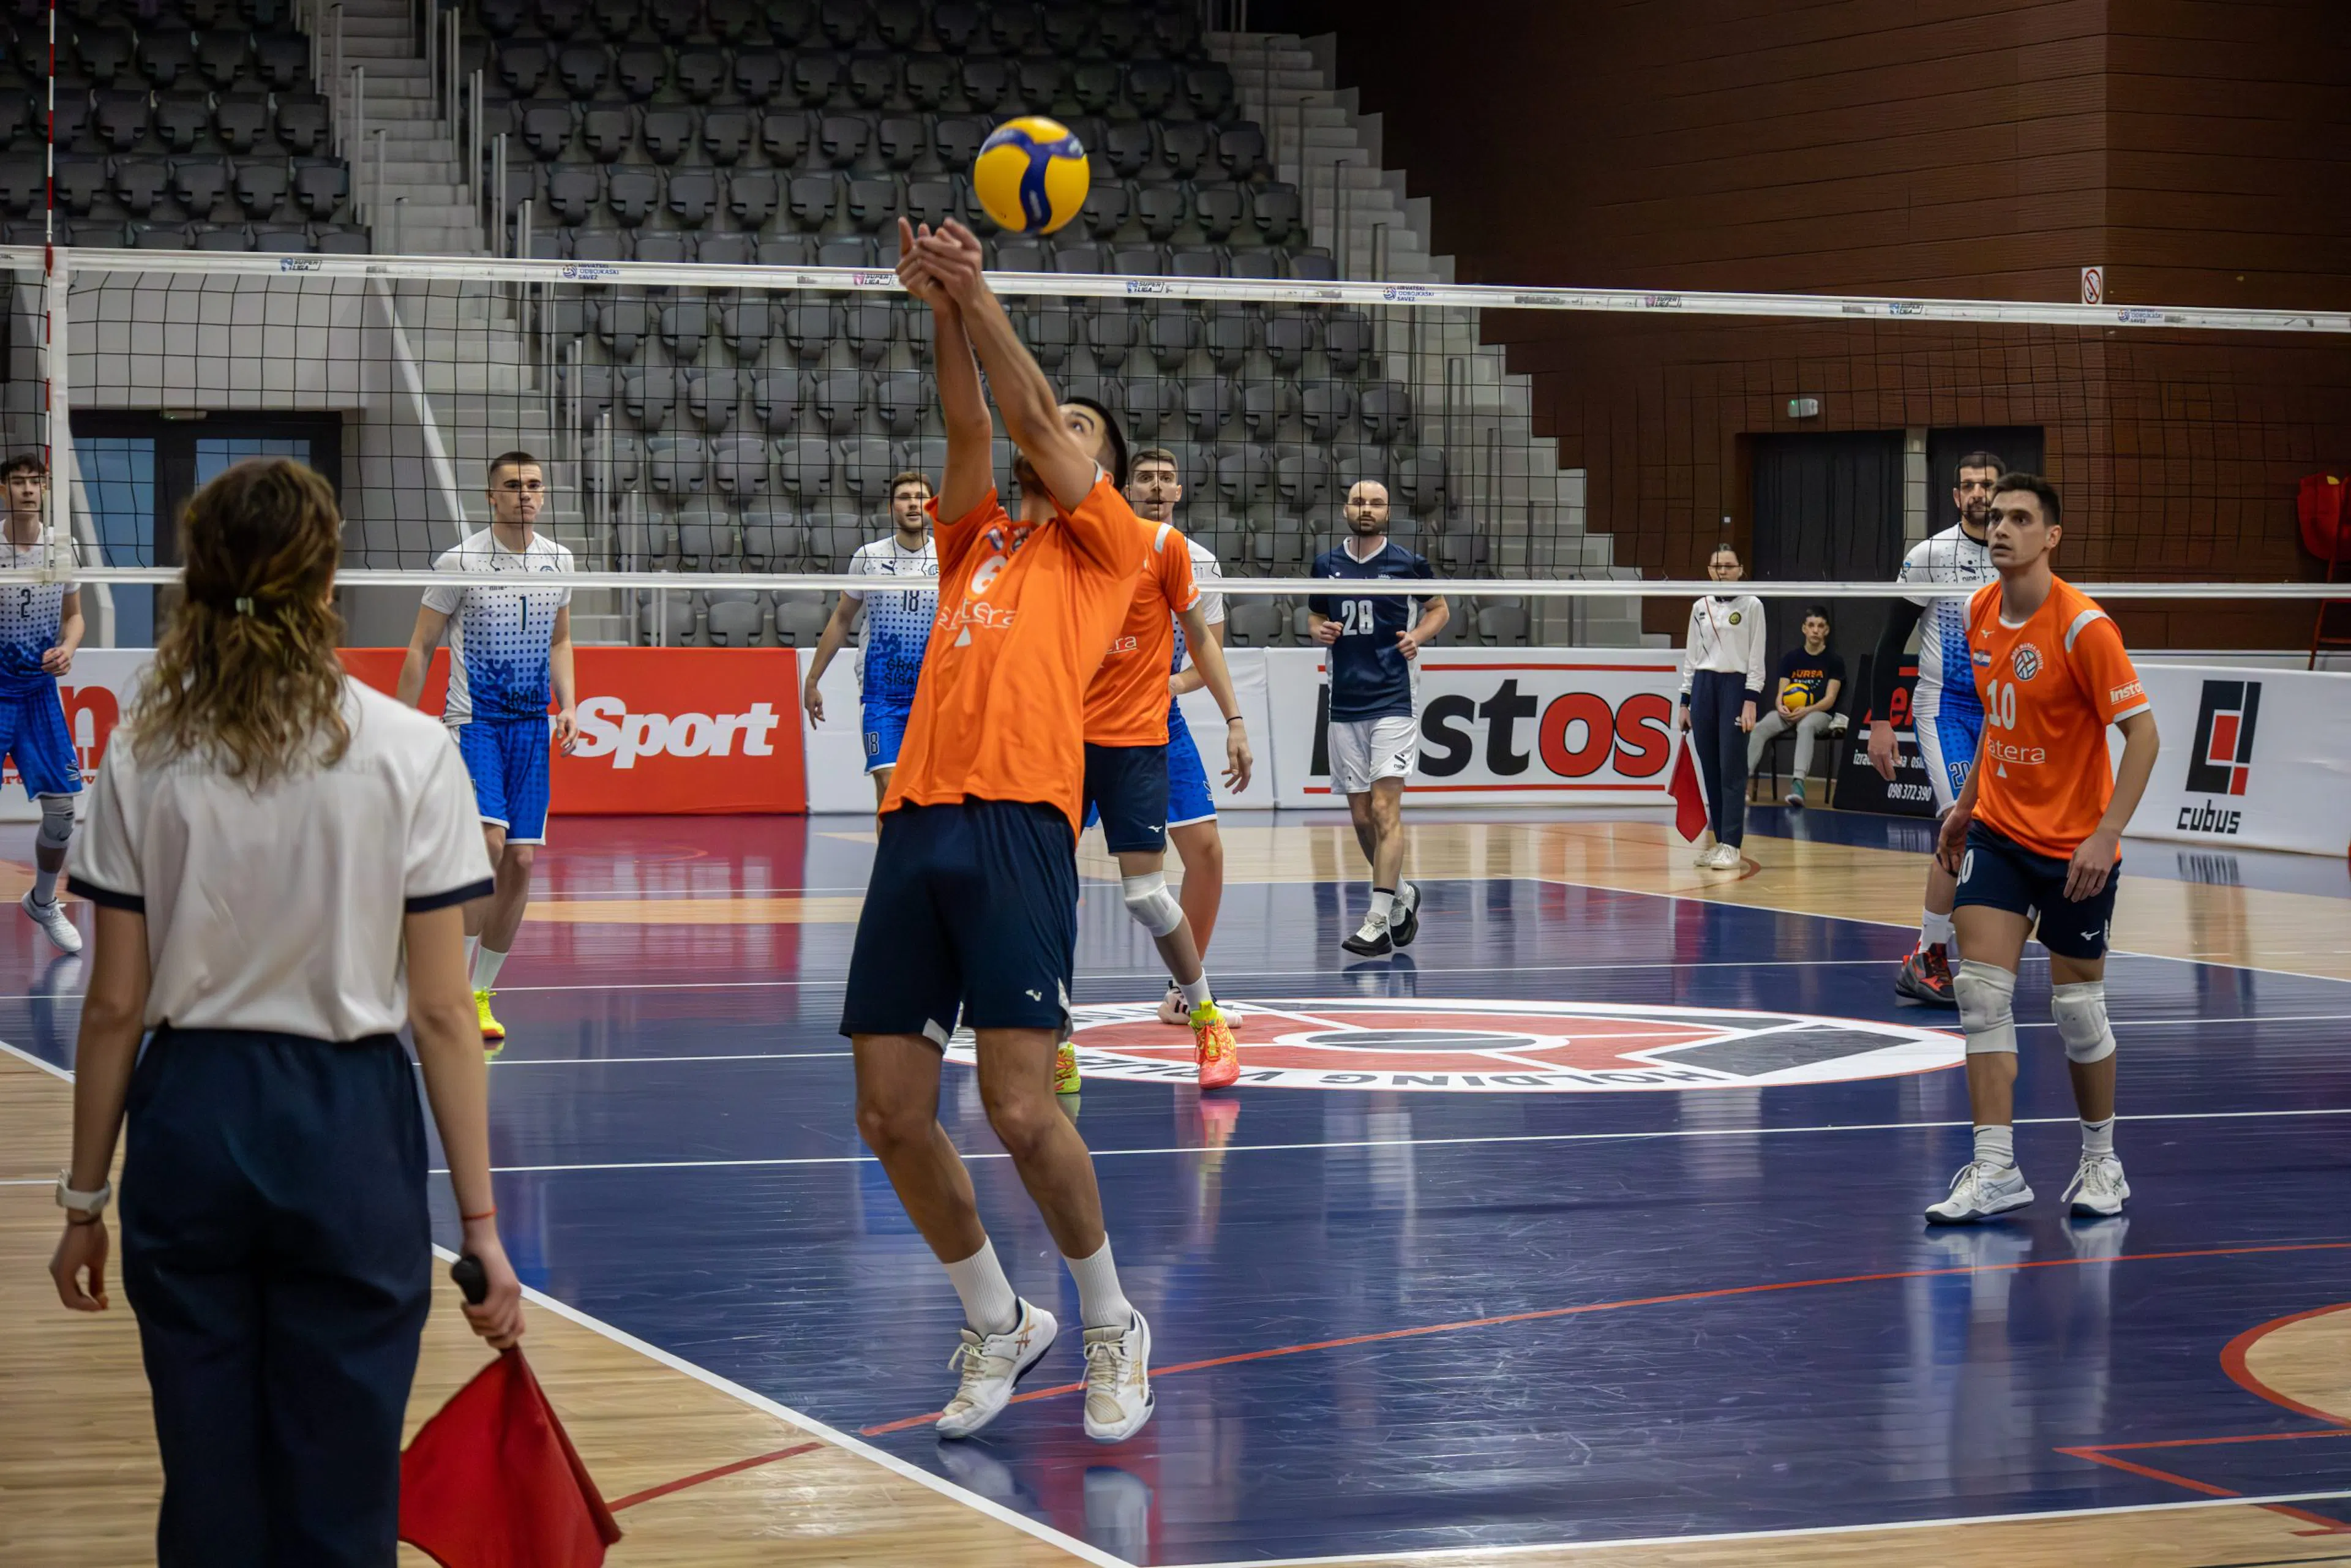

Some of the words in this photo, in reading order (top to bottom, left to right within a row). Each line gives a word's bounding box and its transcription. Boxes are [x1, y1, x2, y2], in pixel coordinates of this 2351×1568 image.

[971, 555, 1008, 595] 6
[21, 588, 31, 618] 2
[519, 596, 527, 631] 1
[902, 590, 920, 612] 18
[1341, 600, 1374, 636] 28
[1987, 679, 2016, 730] 10
[2110, 682, 2143, 703] Insto
[864, 733, 879, 754] 18
[1310, 679, 1671, 777] Istos
[1949, 762, 1971, 789] 20
[1887, 782, 1903, 799] 098
[1903, 784, 1918, 800] 372
[1916, 786, 1932, 802] 390
[2177, 799, 2241, 835] cubus
[1956, 849, 1974, 888] 0
[1319, 1071, 1729, 1087] HOLDING
